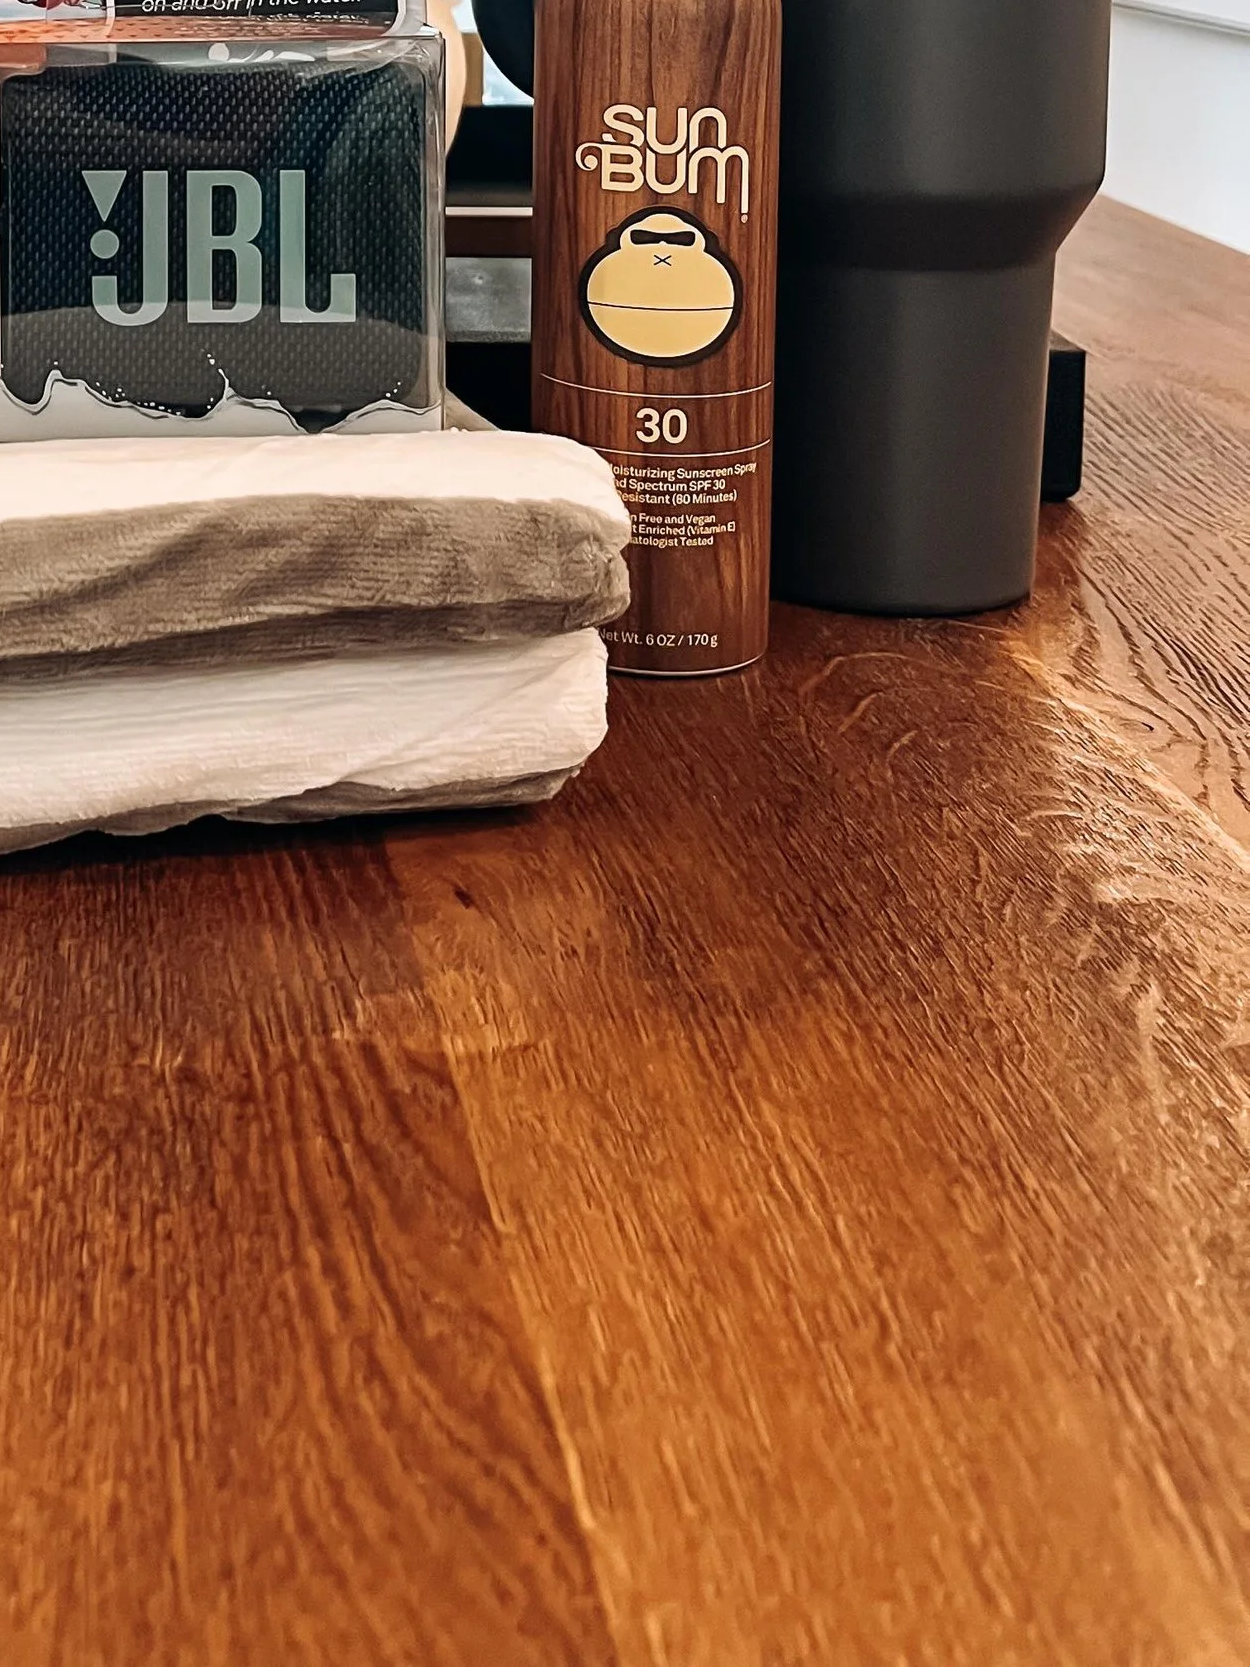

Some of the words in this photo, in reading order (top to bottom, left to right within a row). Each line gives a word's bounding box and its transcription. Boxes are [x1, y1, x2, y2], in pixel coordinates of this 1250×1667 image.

[81, 169, 357, 327] JBL
[635, 407, 688, 444] 30
[611, 464, 677, 482] oisturizing
[676, 466, 734, 480] Sunscreen
[734, 462, 757, 476] Spray
[628, 478, 688, 492] Spectrum
[689, 479, 712, 492] SPF
[712, 478, 726, 491] 30
[692, 488, 738, 504] Minutes)
[638, 512, 663, 524] Free
[664, 514, 685, 524] and
[685, 514, 716, 526] Vegan
[638, 524, 686, 536] Enriched
[686, 523, 727, 537] (Vitamin
[630, 535, 679, 549] atologist
[679, 535, 714, 547] Tested
[621, 630, 643, 645] Wt.
[645, 633, 655, 646] 6
[656, 633, 676, 647] OZ
